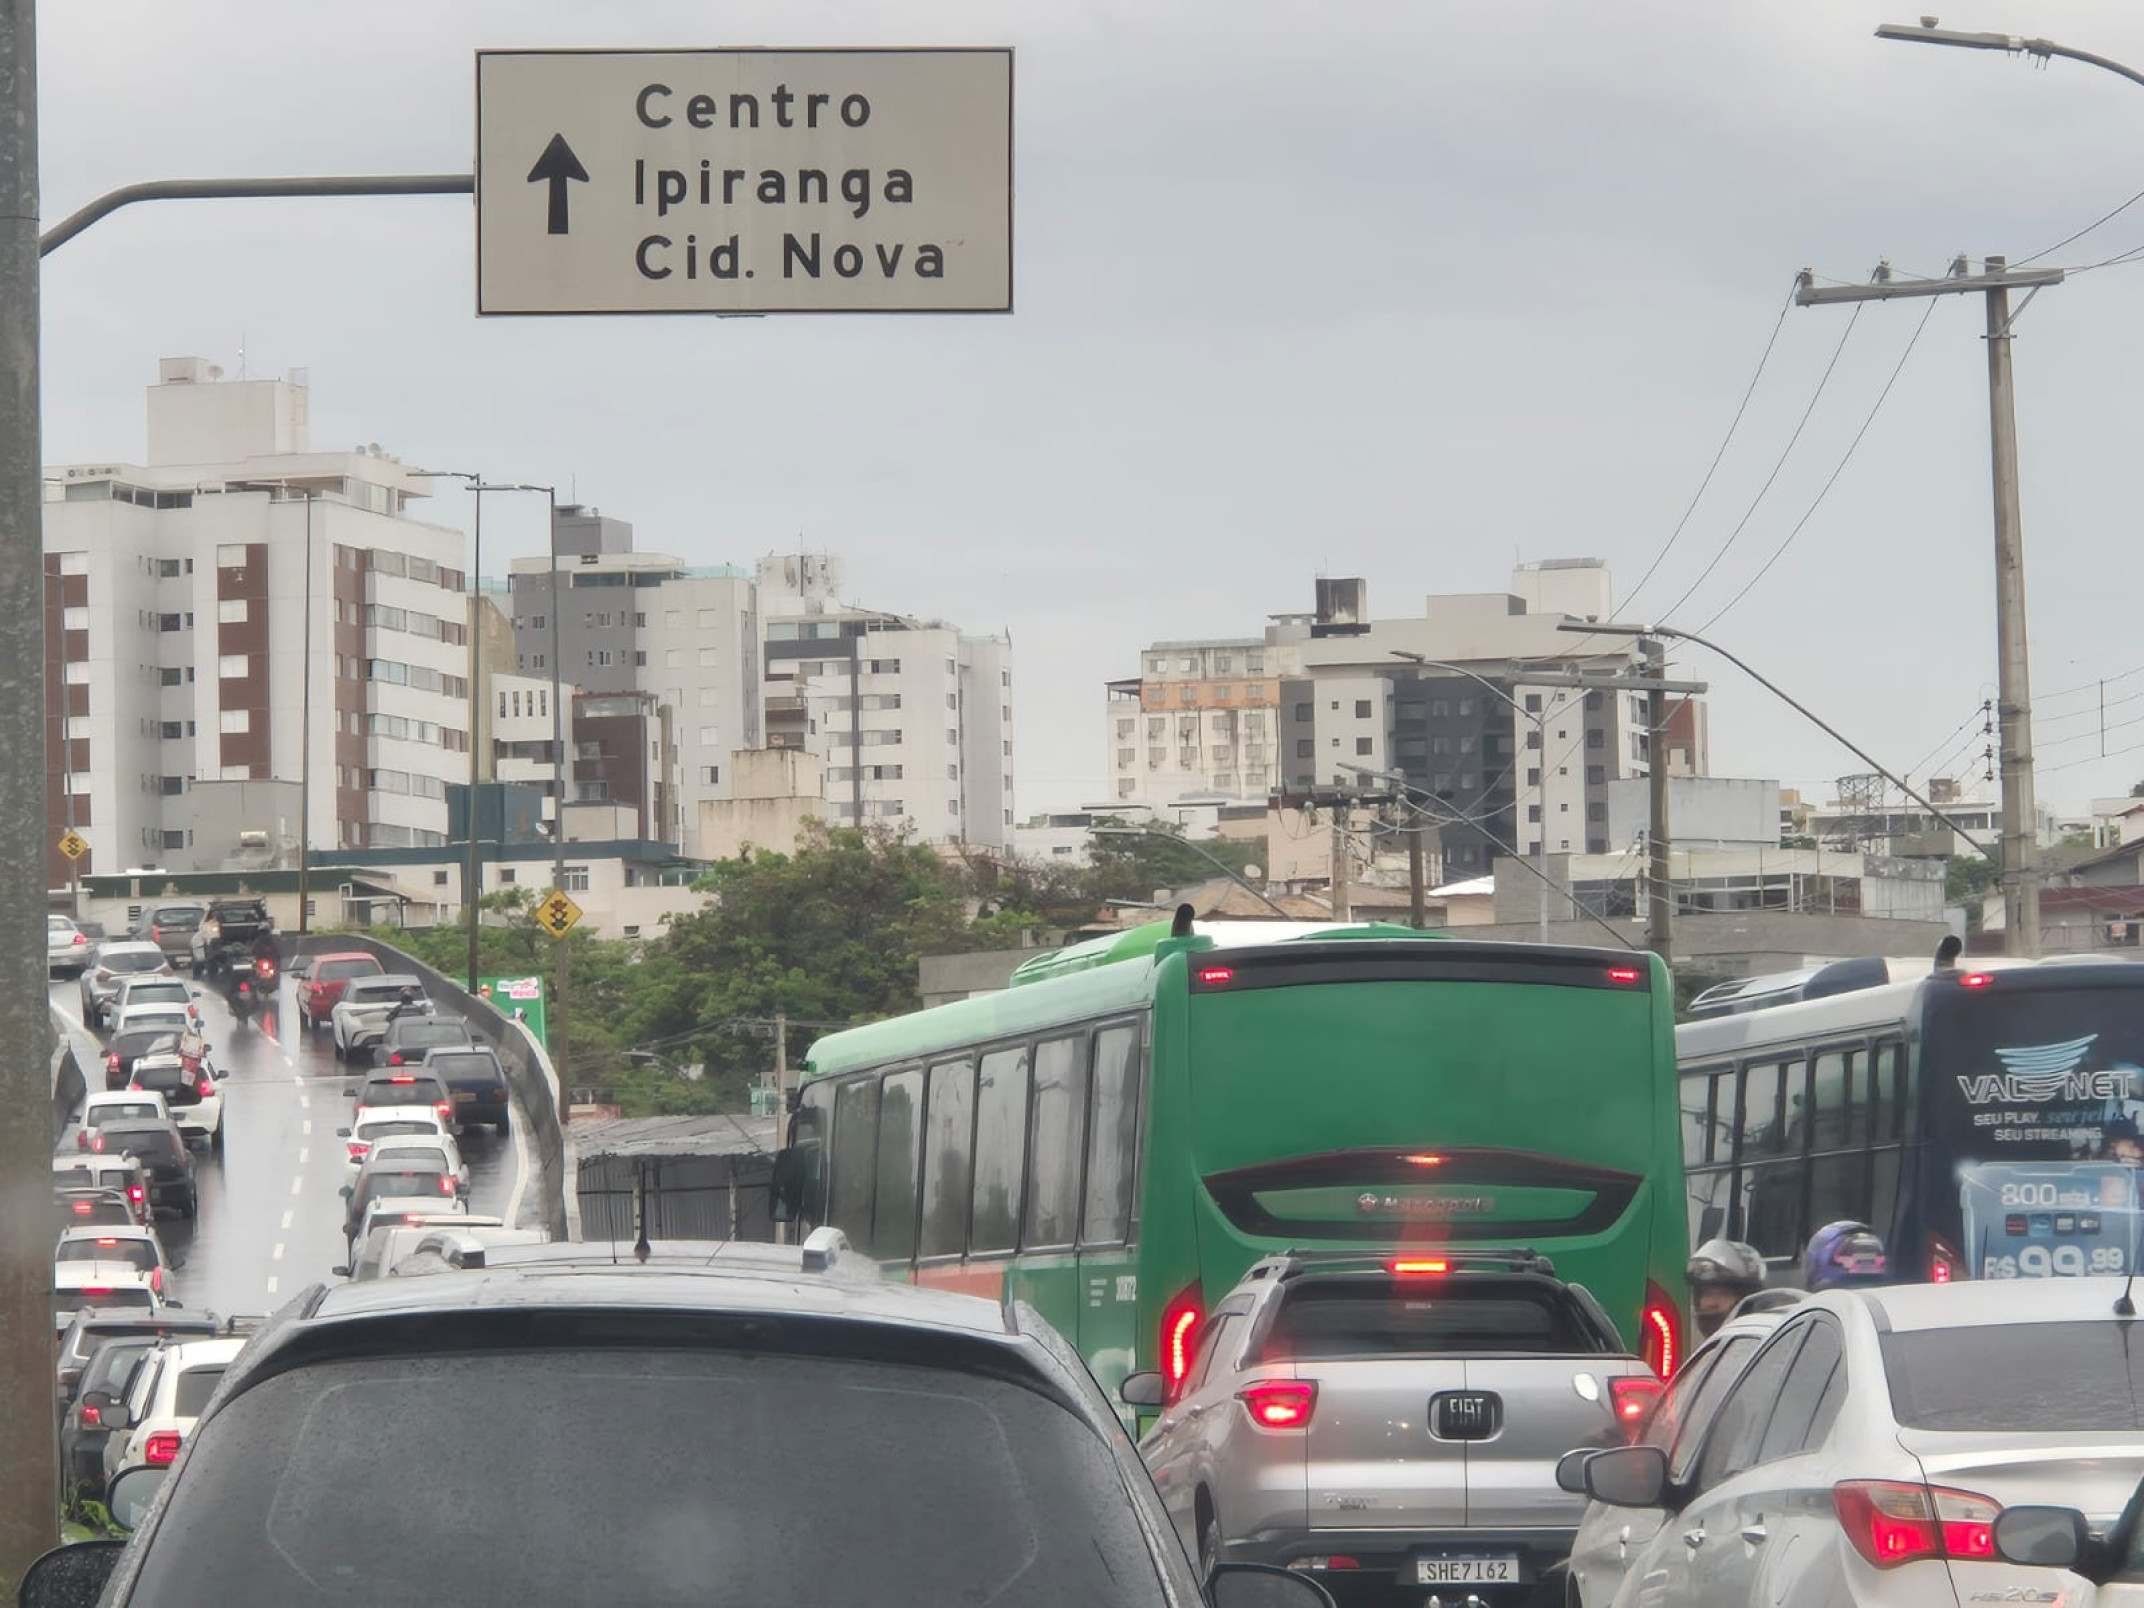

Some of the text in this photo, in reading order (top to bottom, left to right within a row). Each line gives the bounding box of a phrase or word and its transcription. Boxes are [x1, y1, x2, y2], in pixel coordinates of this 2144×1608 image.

[635, 83, 871, 128] Centro
[634, 159, 914, 218] Ipiranga
[635, 233, 944, 280] Cid. Nova
[1973, 1112, 2001, 1126] SEU
[1993, 1126, 2102, 1142] SEU STREAMING
[2000, 1183, 2057, 1206] 800
[1448, 1398, 1485, 1414] FIAT
[1426, 1562, 1508, 1581] SHE7162
